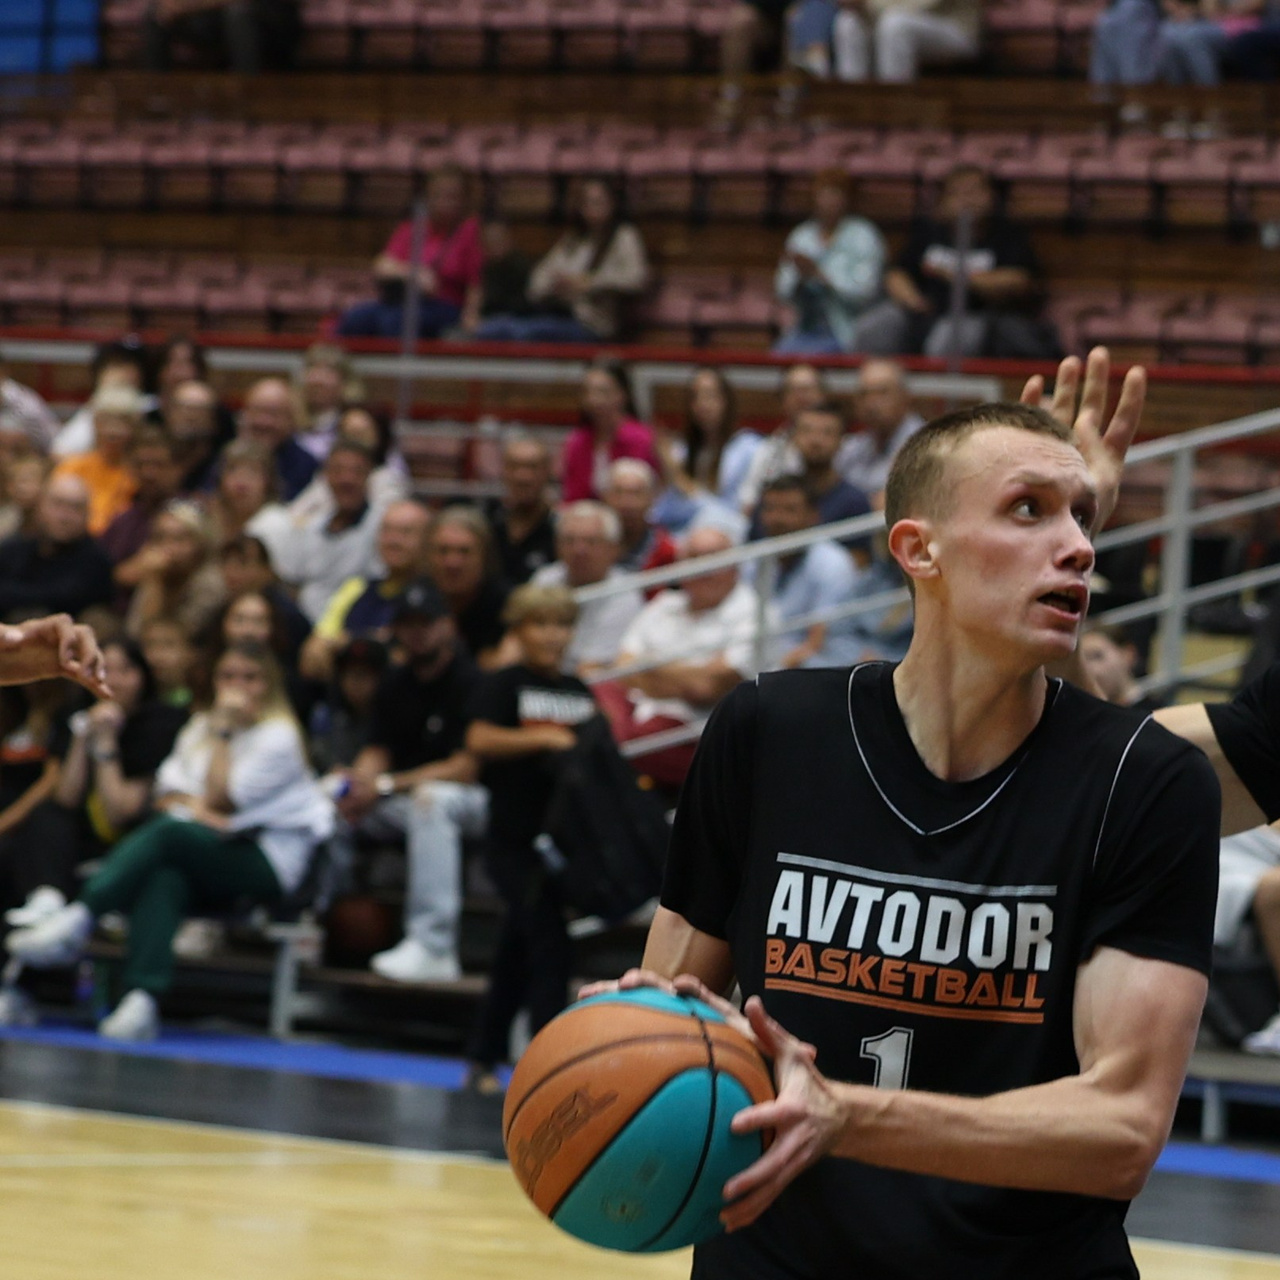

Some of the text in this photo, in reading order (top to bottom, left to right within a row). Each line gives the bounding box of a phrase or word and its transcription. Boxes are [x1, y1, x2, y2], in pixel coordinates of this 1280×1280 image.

[766, 869, 1053, 972] AVTODOR
[765, 938, 1045, 1009] BASKETBALL
[859, 1026, 914, 1091] 1
